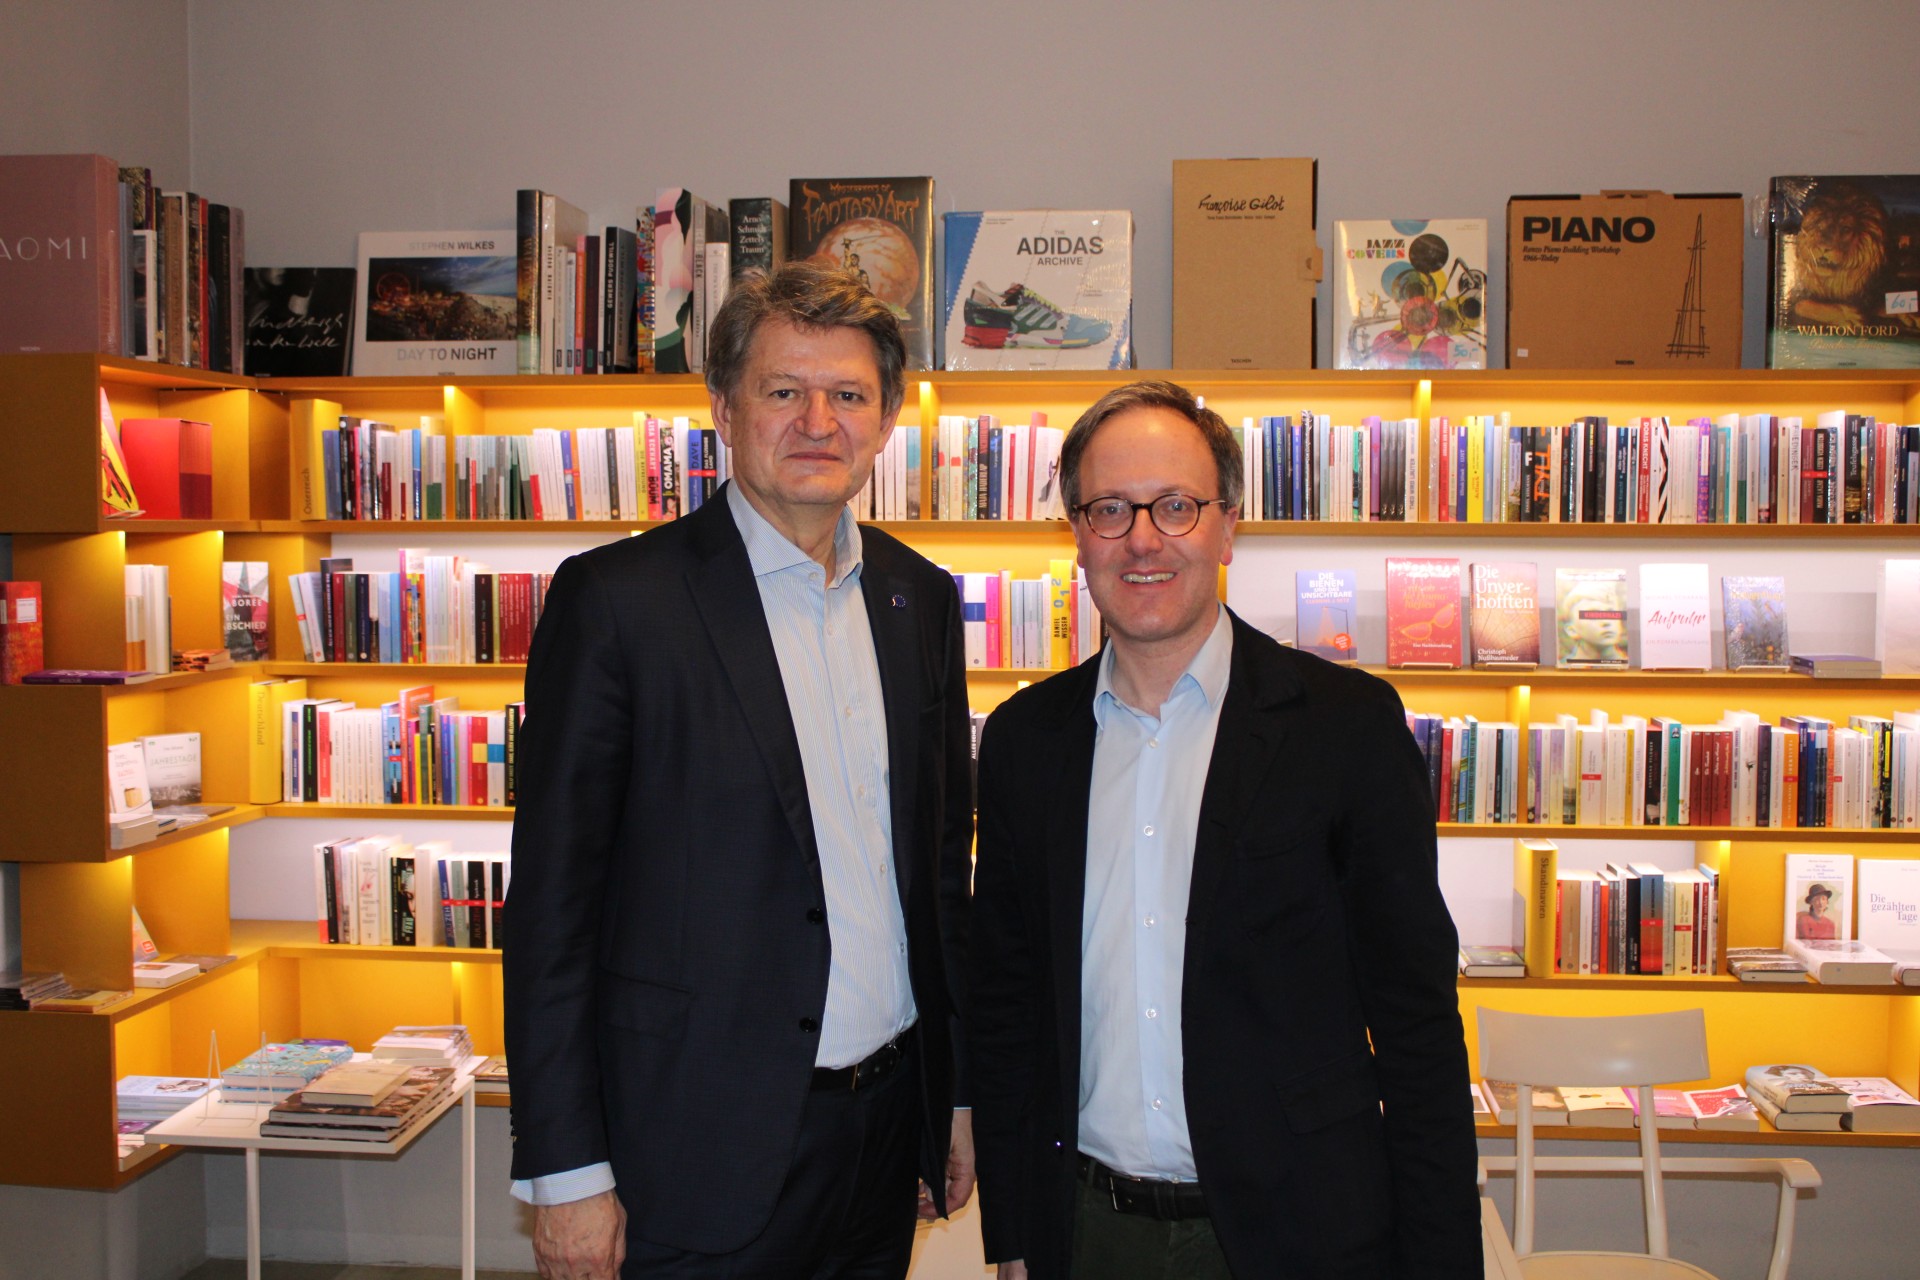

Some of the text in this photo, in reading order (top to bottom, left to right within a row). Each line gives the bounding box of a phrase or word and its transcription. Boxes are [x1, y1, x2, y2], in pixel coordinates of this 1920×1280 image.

[1198, 194, 1285, 214] Françoise Gilot
[742, 215, 762, 223] Arno
[803, 182, 920, 242] FANTASY ART
[737, 224, 768, 233] Schmidt
[1522, 216, 1656, 244] PIANO
[408, 241, 496, 251] STEPHEN WILKES
[740, 234, 765, 243] Zettels
[1016, 236, 1104, 256] ADIDAS
[1367, 239, 1405, 249] JAZZ
[741, 246, 765, 254] Traum
[1347, 249, 1406, 260] COVERS
[1522, 246, 1622, 257] Renzo Piano Building Workshop
[696, 254, 706, 279] BLACK
[1037, 257, 1085, 266] ARCHIVE
[606, 242, 617, 309] GEWERS PUDEWILL
[1796, 325, 1900, 337] WALTON FORD
[396, 347, 498, 361] DAY TO NIGHT
[1642, 422, 1651, 442] DORIS
[647, 421, 659, 505] LISA ECKHART BOUM
[690, 441, 700, 470] DAVE
[1525, 452, 1533, 467] F
[1641, 443, 1650, 470] KNECHT
[1849, 435, 1858, 476] Teufelsgasse
[663, 448, 673, 490] OMAMA
[1534, 443, 1551, 502] TYLL
[1816, 479, 1824, 494] LAZAR
[1318, 572, 1335, 581] DIE
[1474, 564, 1500, 579] Die
[1051, 578, 1062, 587] 2
[1308, 580, 1345, 589] BIENEN
[1474, 579, 1532, 595] Unver-
[1300, 590, 1354, 600] UNSICHTBARE
[1475, 593, 1536, 609] hofften
[1647, 608, 1707, 630] Aufruhr
[1052, 617, 1061, 638] DANIEL
[1061, 616, 1069, 639] WISSER
[1477, 649, 1507, 657] Christoph
[256, 690, 267, 746] Deutschland
[150, 754, 197, 767] JAHRESTAGE
[1539, 857, 1551, 919] Skandinavien
[1869, 892, 1886, 903] Die
[1871, 901, 1917, 914] gezählten
[1895, 910, 1919, 924] Tage
